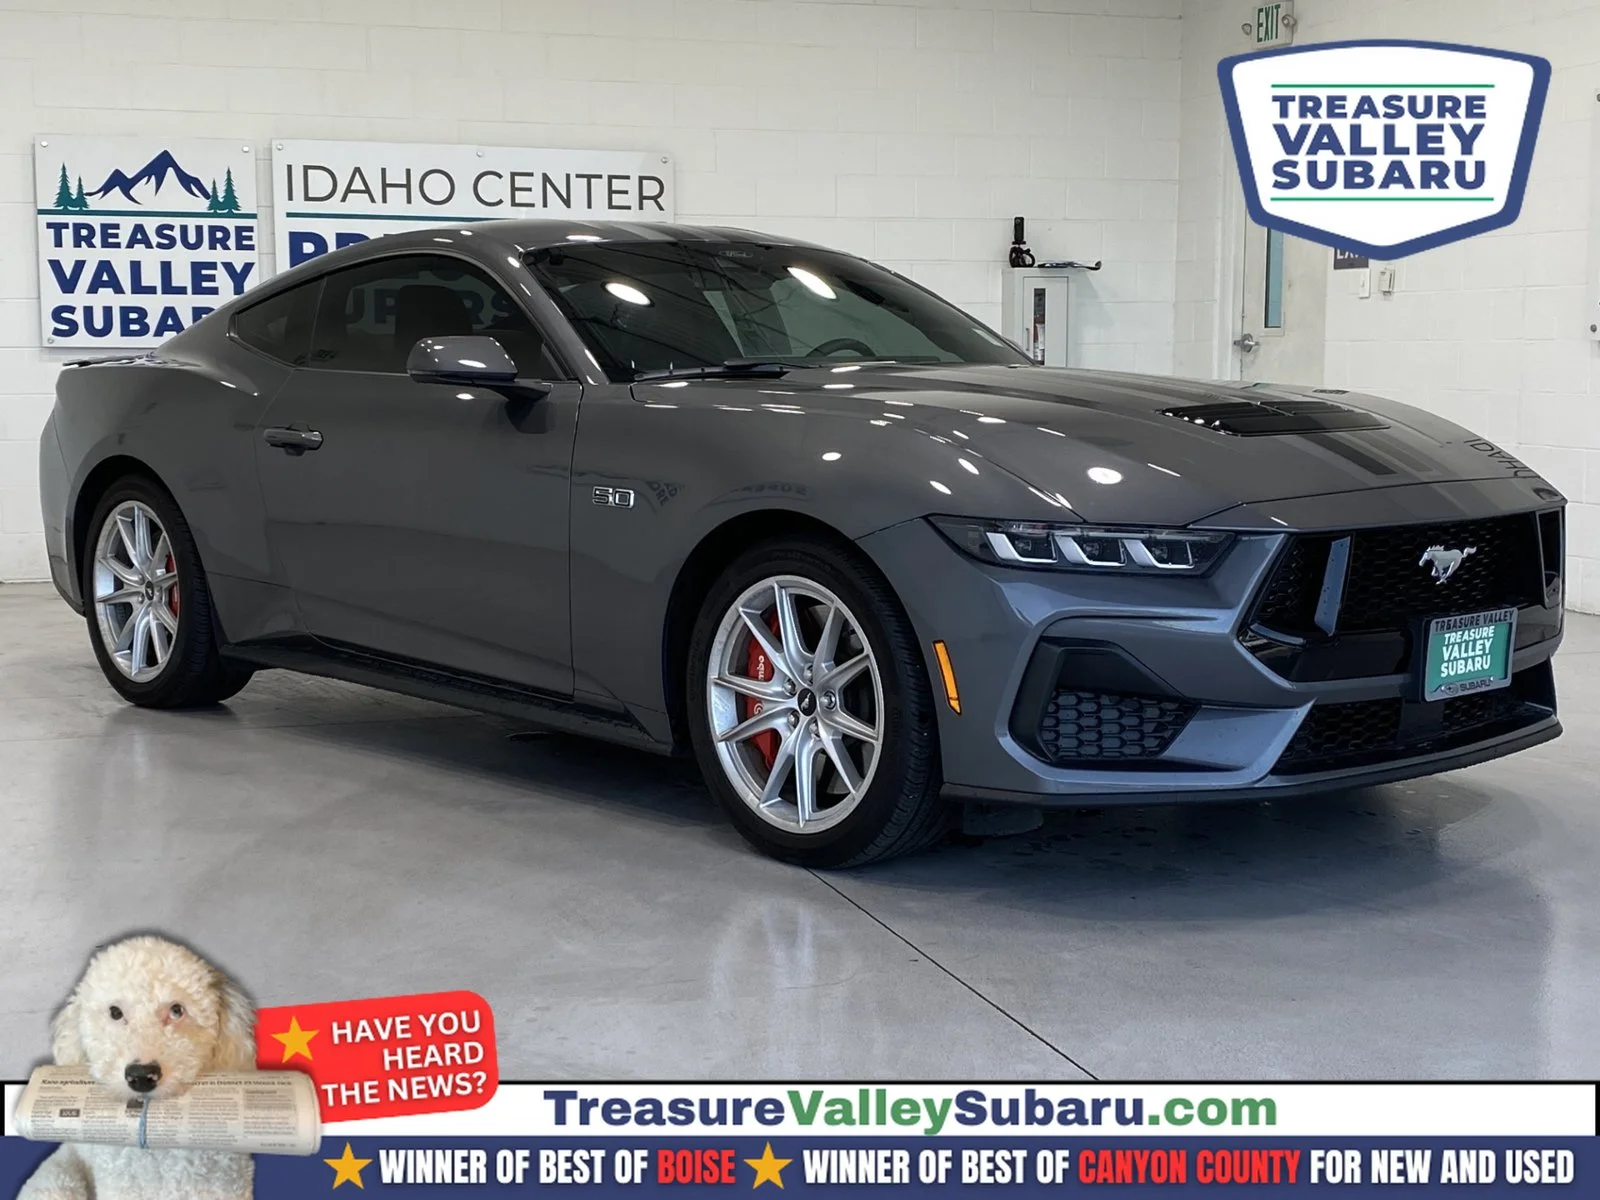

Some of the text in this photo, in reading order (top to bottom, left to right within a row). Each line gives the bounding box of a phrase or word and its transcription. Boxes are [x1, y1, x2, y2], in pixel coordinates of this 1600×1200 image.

[1257, 4, 1280, 43] EXIT
[286, 164, 666, 212] IDAHO CENTER
[46, 222, 256, 251] TREASURE
[48, 259, 255, 296] VALLEY
[1435, 610, 1514, 632] TREASURE VALLEY
[1444, 626, 1495, 645] TREASURE
[1442, 638, 1493, 661] VALLEY
[1440, 655, 1491, 677] SUBARU
